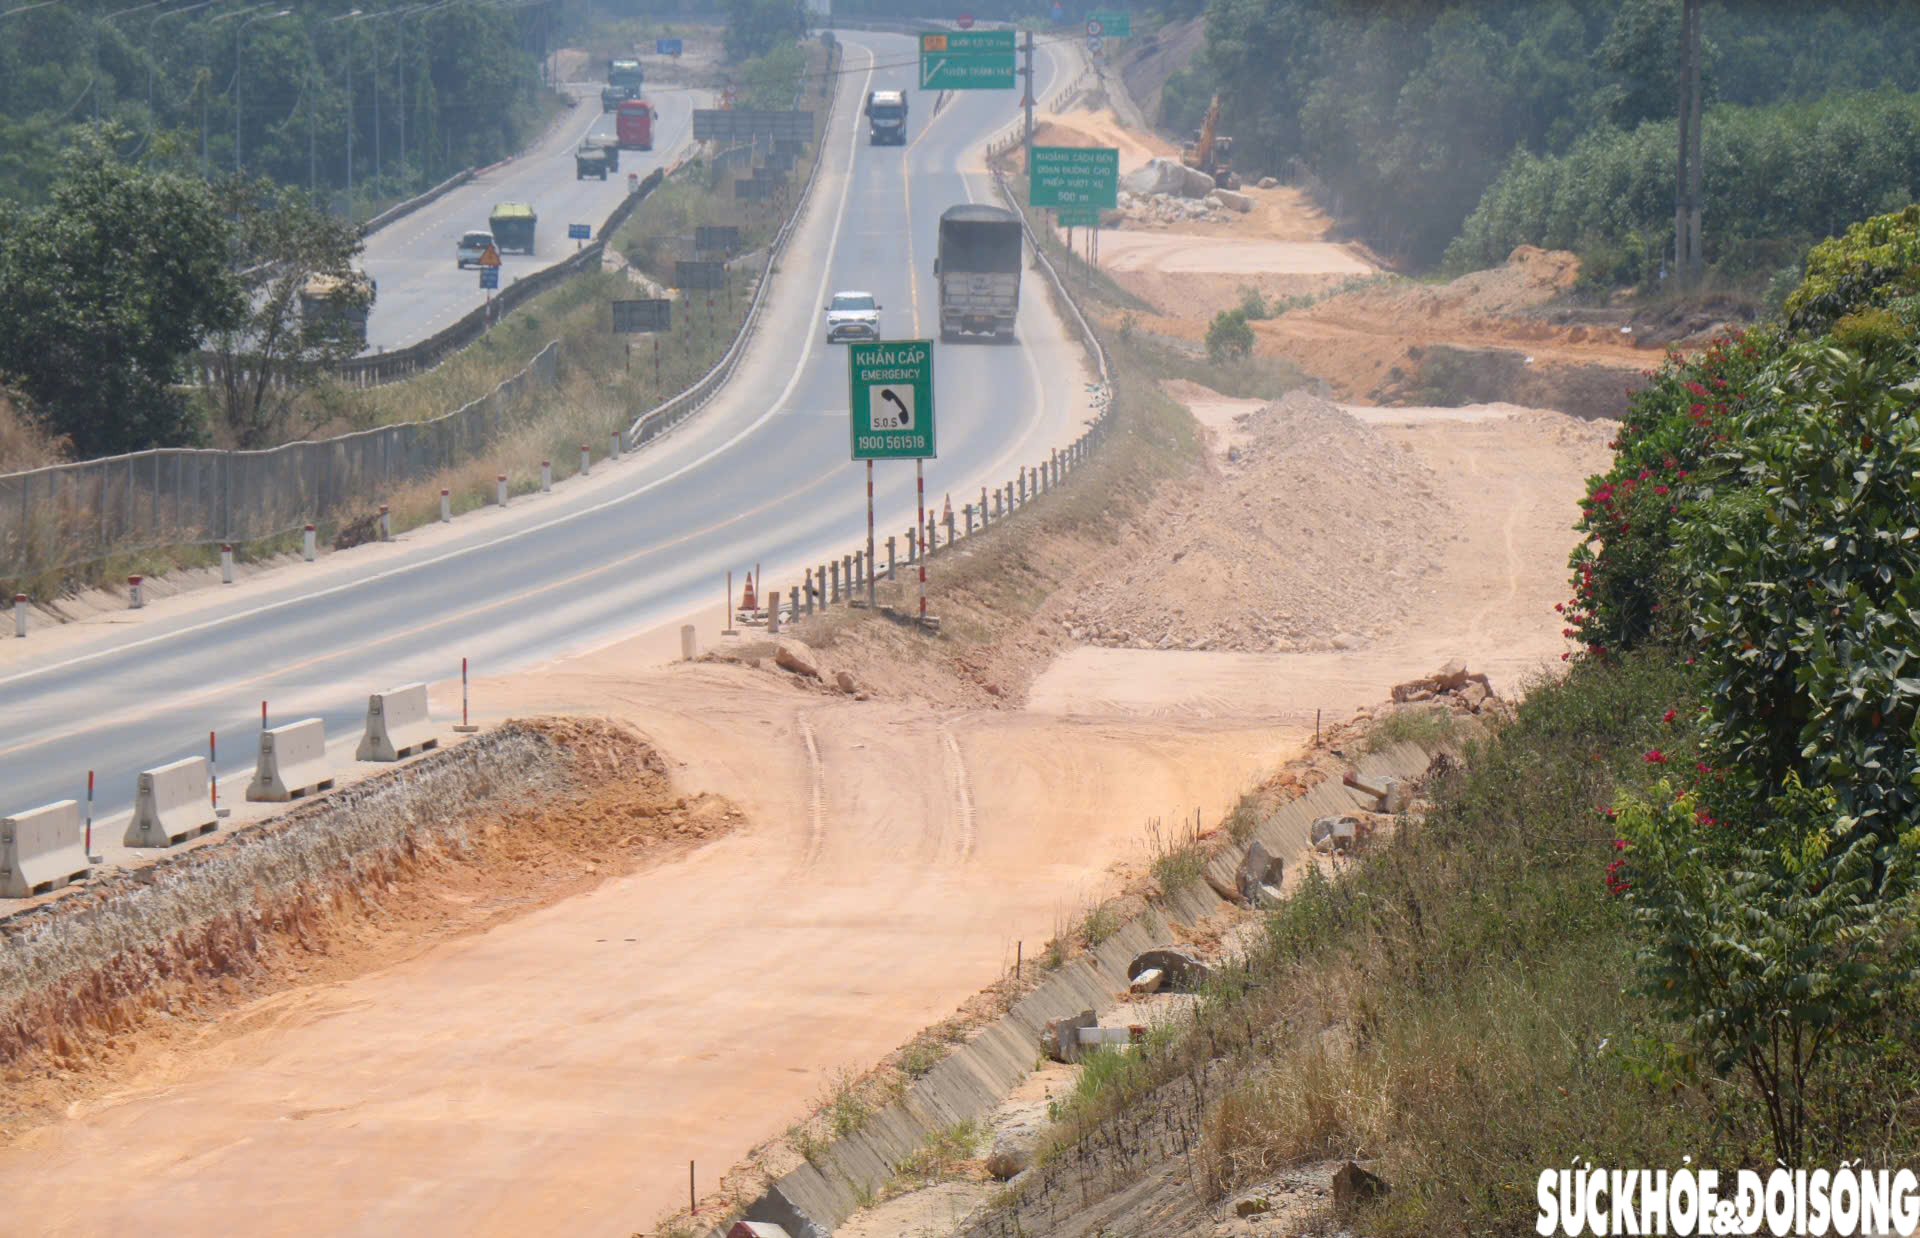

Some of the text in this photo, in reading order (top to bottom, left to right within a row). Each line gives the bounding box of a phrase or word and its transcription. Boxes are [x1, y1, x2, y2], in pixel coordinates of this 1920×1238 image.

[1058, 191, 1076, 201] 500
[856, 345, 925, 365] KHẨN CẤP
[861, 368, 921, 381] EMERGENCY
[858, 435, 926, 449] 1900 561518
